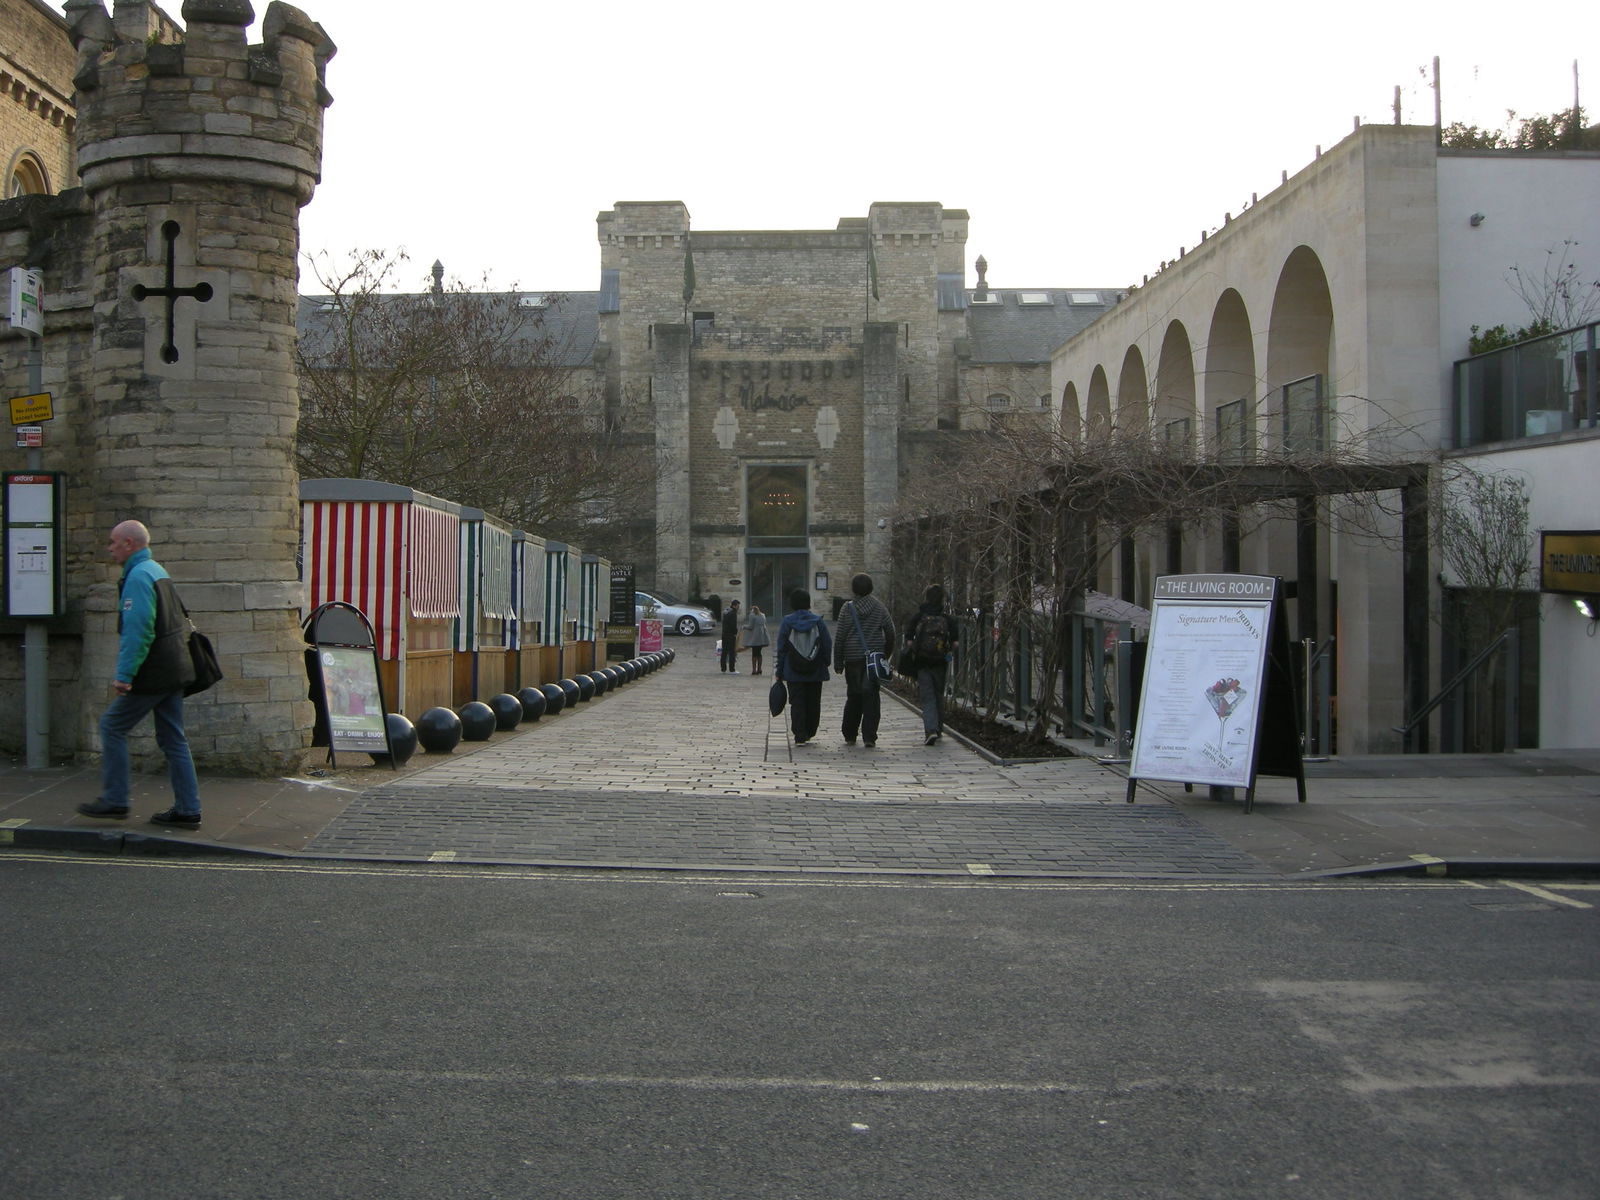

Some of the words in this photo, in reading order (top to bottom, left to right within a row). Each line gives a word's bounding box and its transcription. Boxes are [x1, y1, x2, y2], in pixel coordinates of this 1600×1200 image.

[1167, 581, 1187, 593] THE
[1189, 582, 1226, 594] LIVING
[1228, 582, 1264, 594] ROOM
[1177, 613, 1217, 627] Signature
[1235, 609, 1261, 639] FRIDAYS
